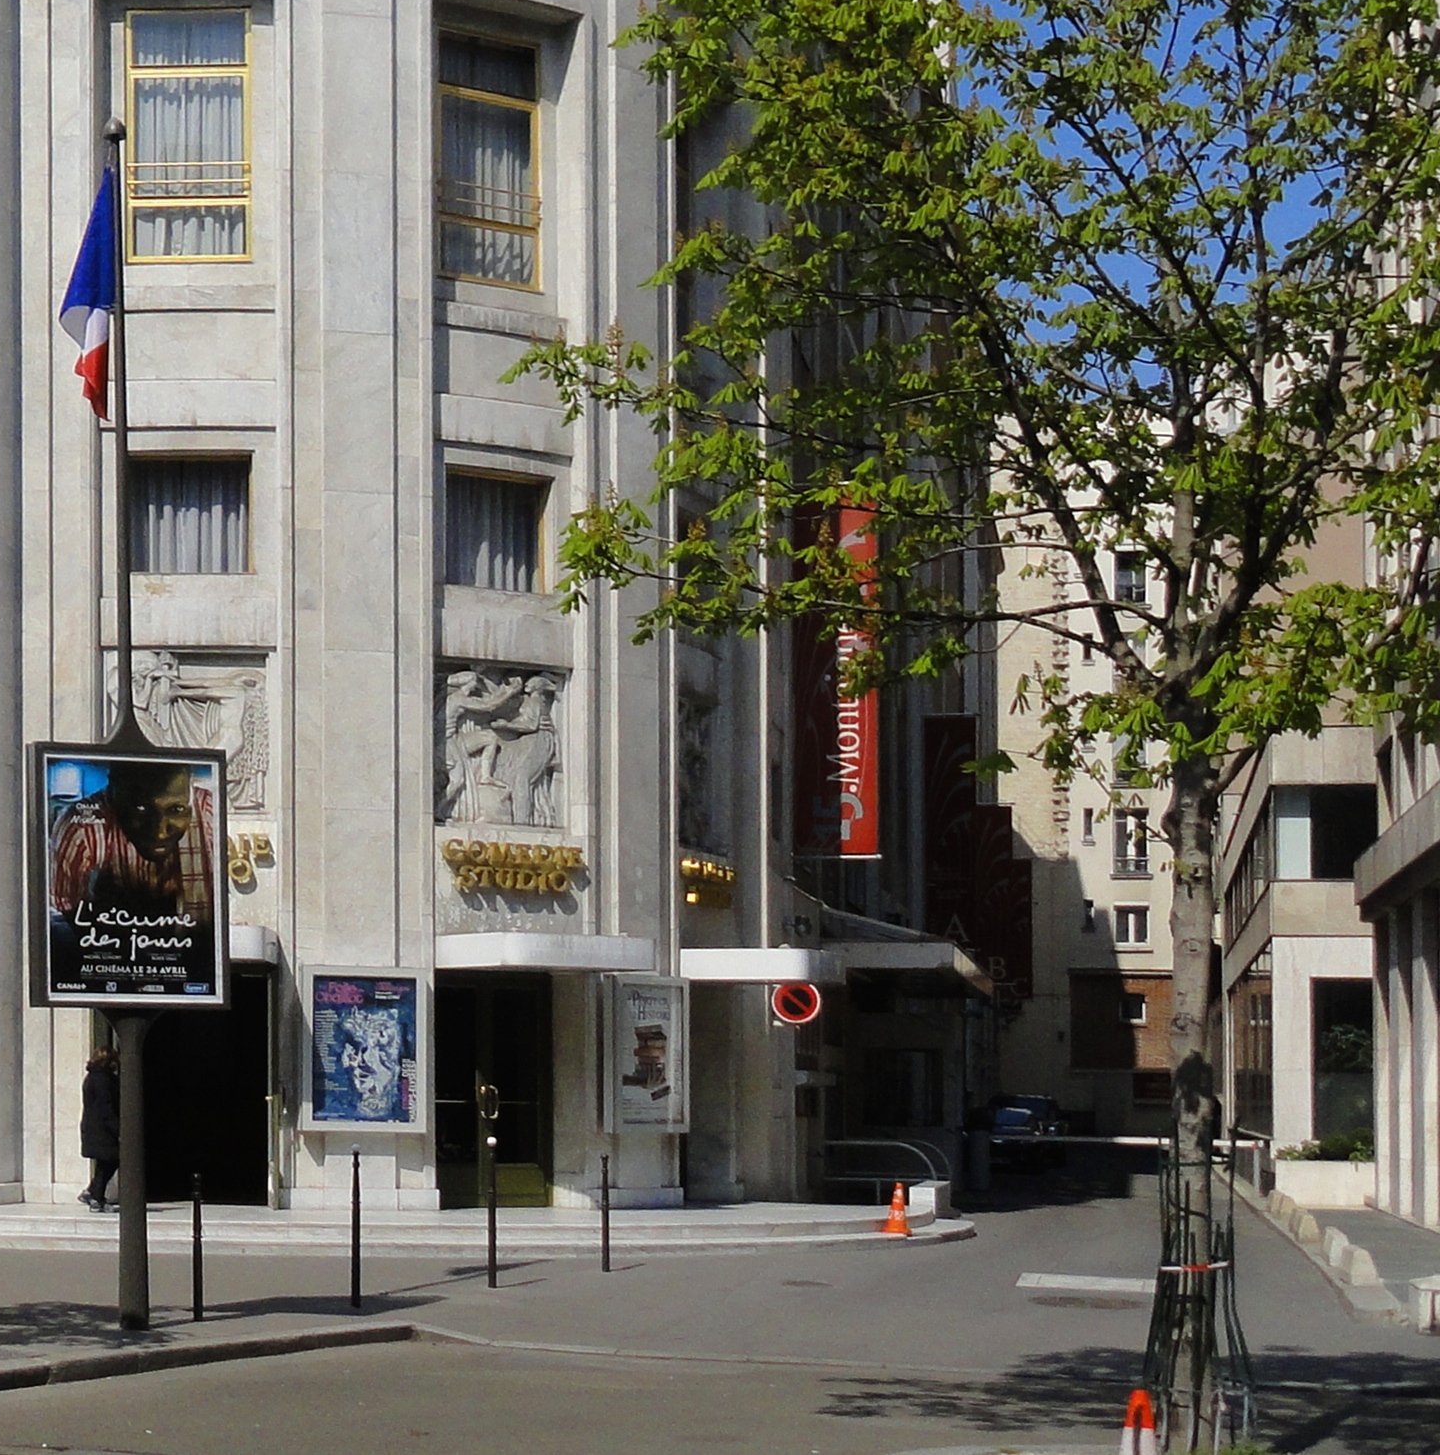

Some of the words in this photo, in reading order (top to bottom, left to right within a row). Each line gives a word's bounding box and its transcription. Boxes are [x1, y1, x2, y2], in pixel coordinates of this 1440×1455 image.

[454, 866, 569, 893] STUDIO
[79, 927, 120, 948] des
[129, 928, 193, 961] jours
[80, 965, 94, 973] AU
[95, 964, 131, 973] CINÉMA
[146, 966, 158, 974] 24
[159, 966, 187, 974] AVRIL
